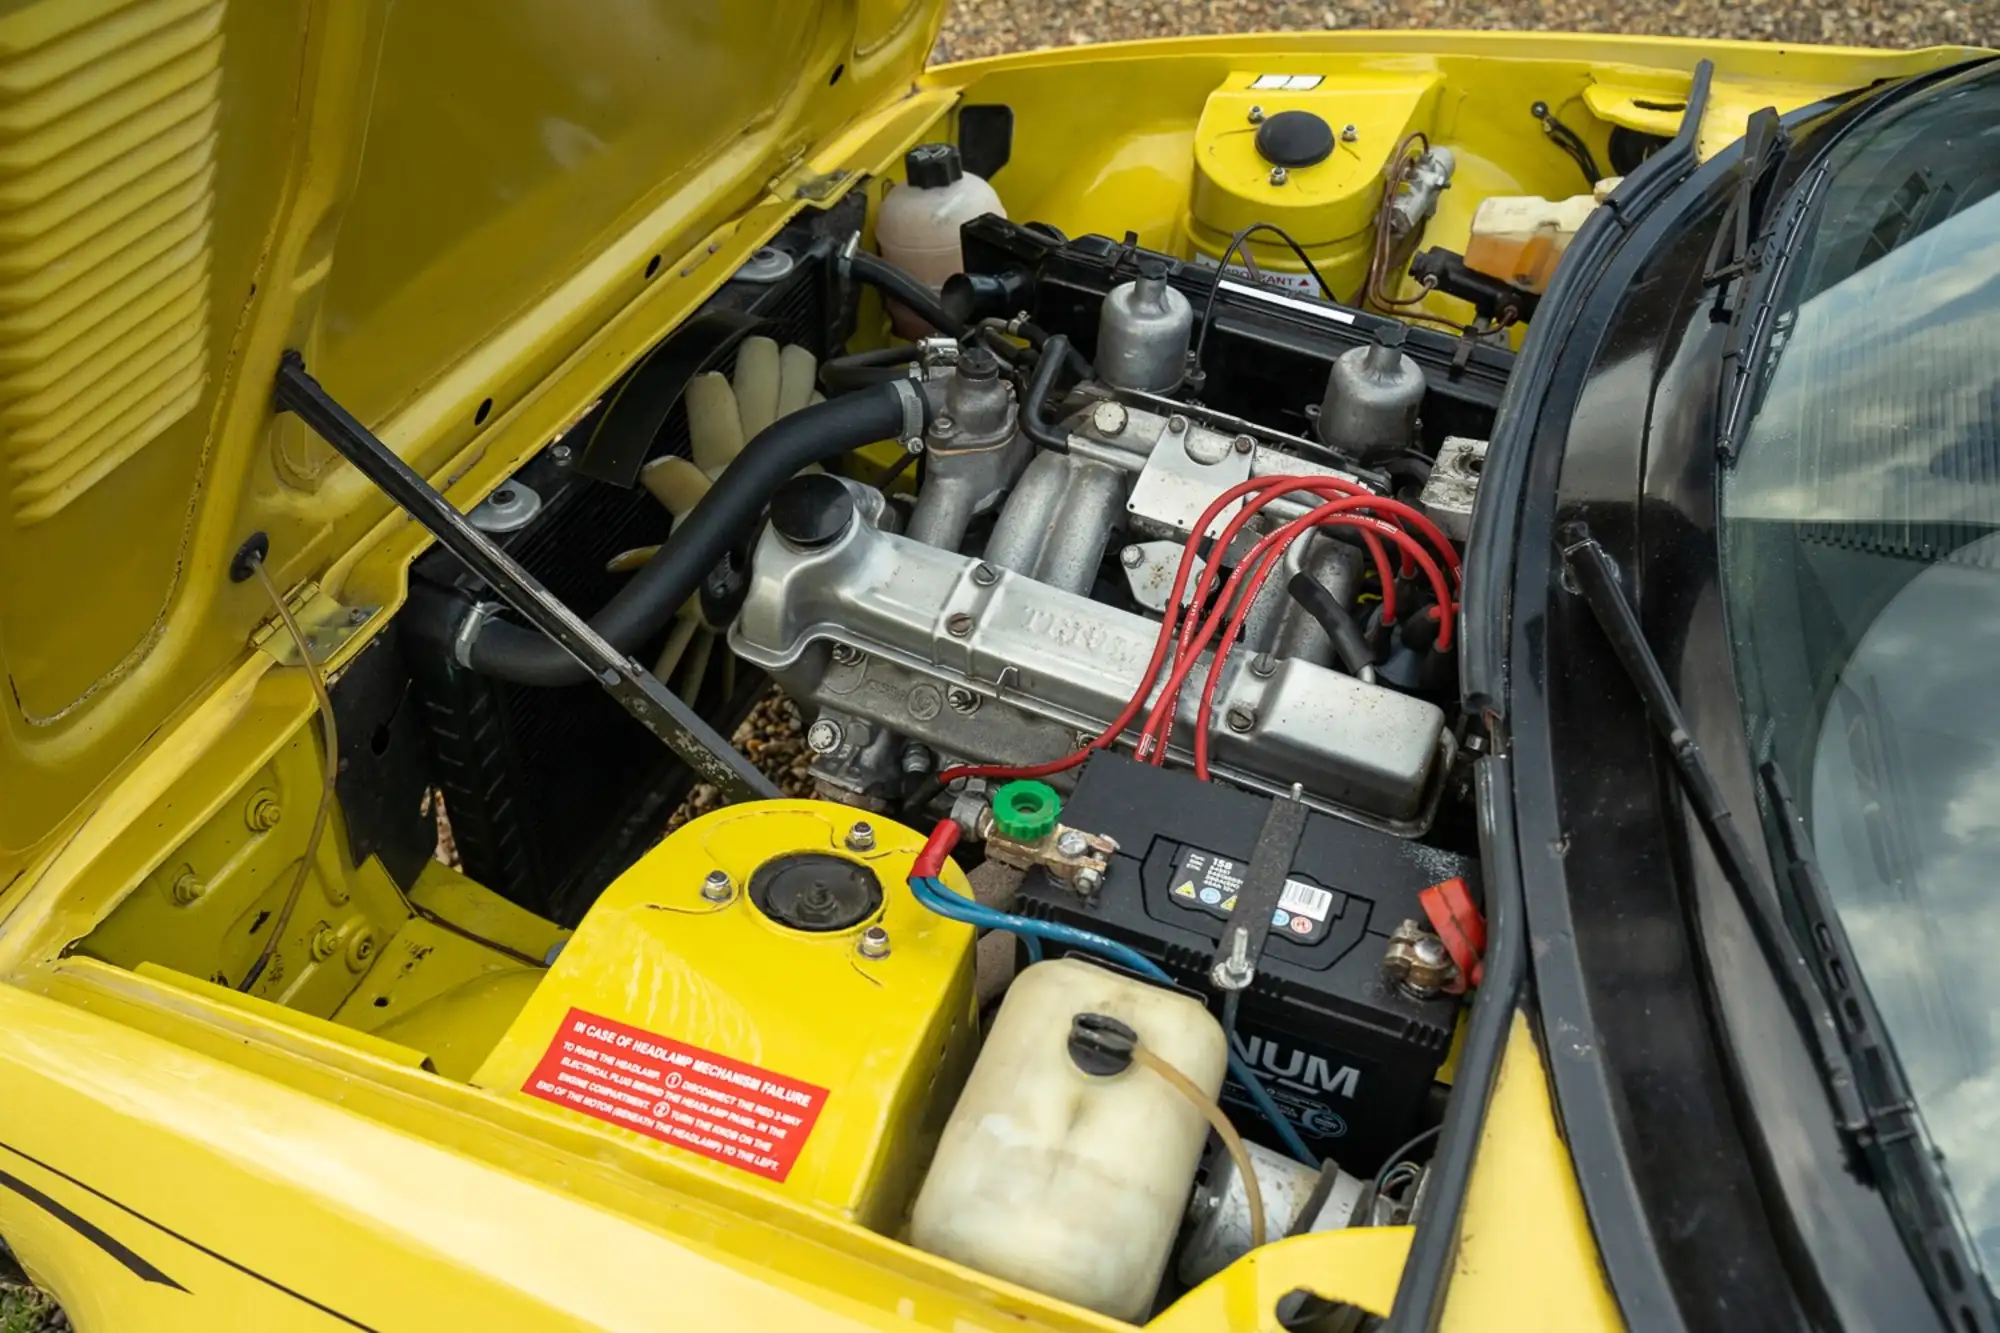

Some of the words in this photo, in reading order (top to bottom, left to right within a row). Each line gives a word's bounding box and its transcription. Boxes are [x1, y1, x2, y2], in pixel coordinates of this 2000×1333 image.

[561, 1057, 608, 1079] ELECTRICAL
[607, 1073, 633, 1086] PLUG
[631, 1080, 664, 1097] BEHIND
[664, 1090, 682, 1103] THE
[680, 1097, 729, 1118] HEADLAMP
[755, 1123, 768, 1132] IN
[769, 1126, 786, 1138] THE
[564, 1042, 574, 1052] TO
[574, 1045, 599, 1060] RAISE
[600, 1054, 616, 1066] THE
[681, 1081, 737, 1104] DISCONNECT
[738, 1099, 755, 1112] THE
[752, 1104, 774, 1118] RED
[574, 1022, 586, 1033] IN
[586, 1026, 616, 1044] CASE
[616, 1036, 633, 1048] OF
[632, 1040, 693, 1066] HEADLAMP
[692, 1060, 762, 1090] MECHANISM
[760, 1082, 811, 1107] FAILURE
[536, 1080, 554, 1092] END
[552, 1087, 567, 1096] OF
[567, 1091, 584, 1102] THE
[583, 1097, 614, 1113] MOTOR
[655, 1121, 673, 1134] THE
[721, 1145, 736, 1156] TO
[737, 1149, 756, 1162] THE
[558, 1072, 589, 1089] ENGINE
[671, 1110, 695, 1125] TURN
[695, 1118, 713, 1132] THE
[736, 1134, 754, 1145] ON
[754, 1139, 772, 1152] THE
